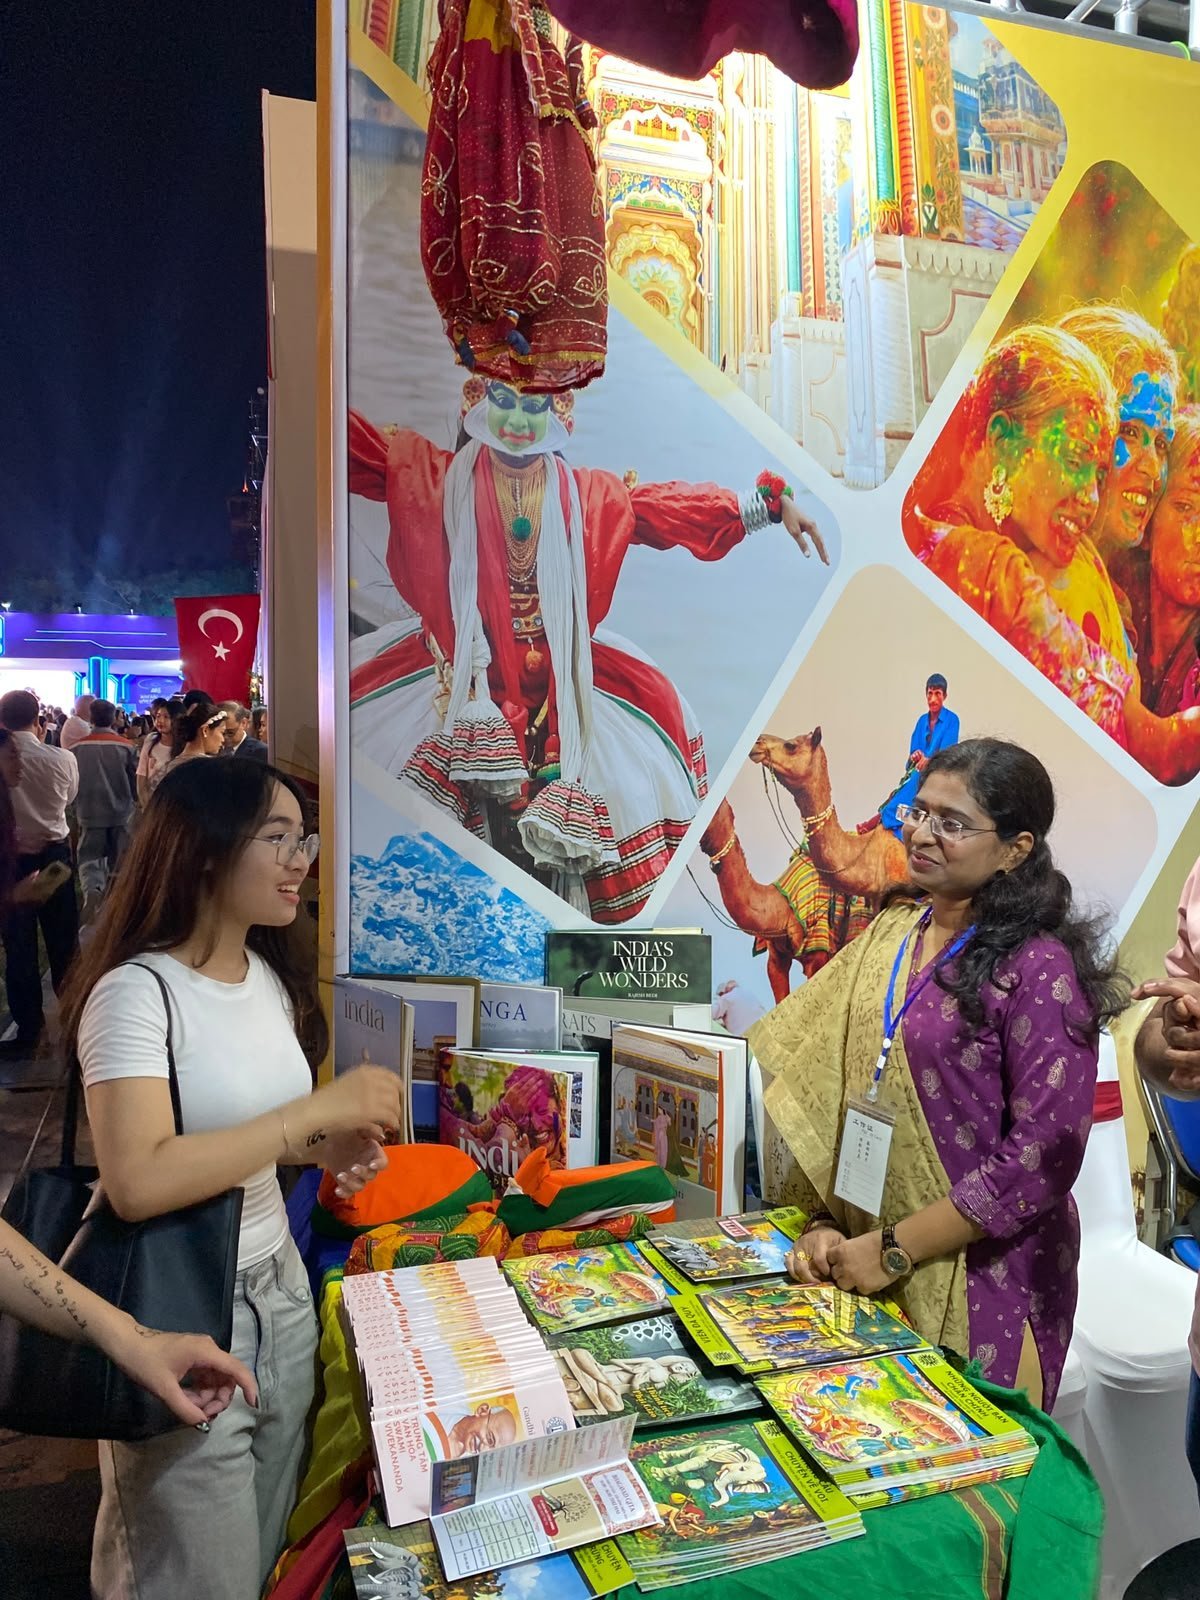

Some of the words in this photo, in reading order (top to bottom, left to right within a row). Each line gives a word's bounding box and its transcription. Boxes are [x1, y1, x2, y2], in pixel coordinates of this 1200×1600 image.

[612, 940, 673, 957] INDIA'S
[619, 957, 667, 973] WILD
[598, 972, 688, 989] WONDERS
[480, 1000, 528, 1022] NGA
[522, 1406, 535, 1435] Gandhi
[991, 1411, 1008, 1423] BẠN
[393, 1420, 405, 1453] SWAMI
[410, 1416, 423, 1448] TRUNG
[383, 1422, 402, 1492] VIVEKANANDA
[784, 1451, 808, 1477] CHUYỆN
[814, 1488, 828, 1502] VOI
